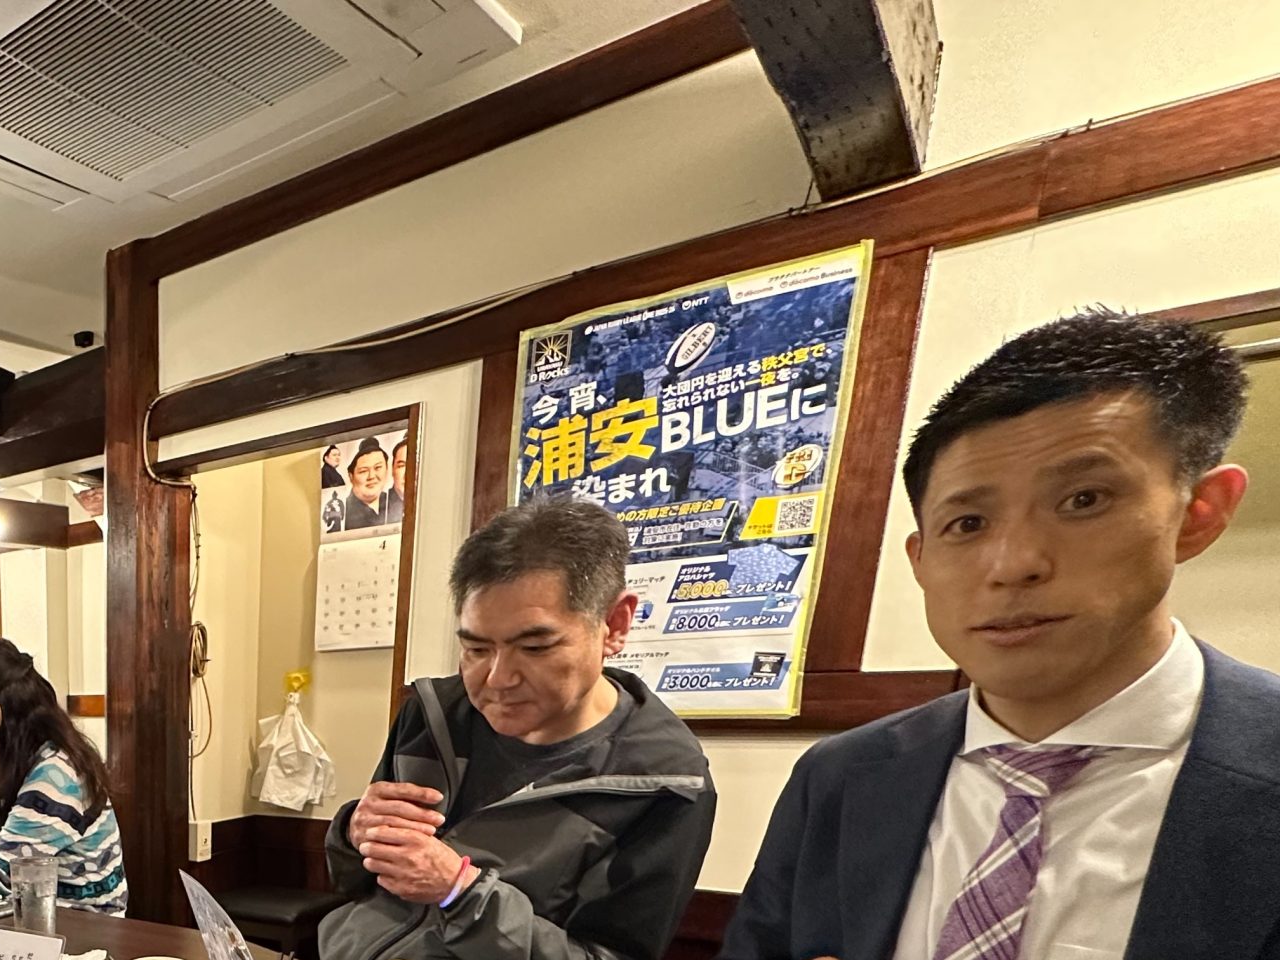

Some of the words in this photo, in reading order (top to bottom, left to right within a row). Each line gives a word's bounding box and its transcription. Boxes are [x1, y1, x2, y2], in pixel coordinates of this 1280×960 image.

[789, 275, 819, 287] docomo
[820, 267, 853, 279] Business
[692, 296, 710, 307] NTT
[681, 325, 712, 360] GILBERT
[662, 368, 799, 413] 忘れられない一夜を。
[677, 572, 715, 583] アロハシャツ
[680, 565, 711, 575] オリジナル
